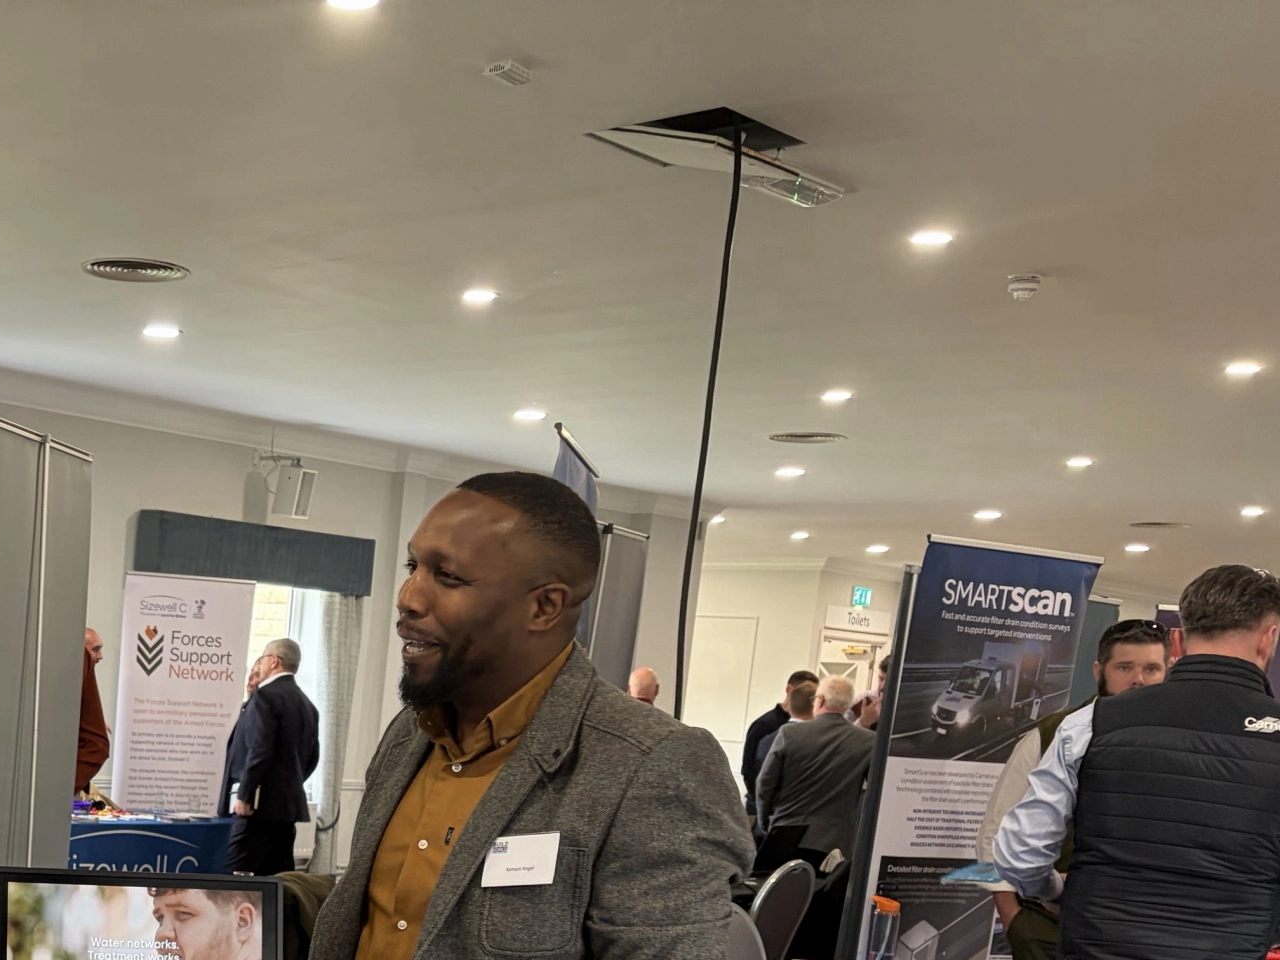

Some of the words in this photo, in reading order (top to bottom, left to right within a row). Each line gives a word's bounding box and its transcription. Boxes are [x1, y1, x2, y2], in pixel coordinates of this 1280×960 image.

[140, 600, 177, 612] Sizewell
[179, 603, 187, 613] C
[942, 579, 1072, 617] SMARTscan
[848, 612, 870, 627] Toilets
[942, 610, 954, 620] Fast
[955, 612, 965, 621] and
[966, 614, 990, 624] accurate
[991, 615, 1004, 625] filter
[1005, 617, 1019, 627] drain
[1021, 619, 1048, 630] condition
[1049, 623, 1071, 633] surveys
[171, 630, 222, 648] Forces
[964, 626, 987, 636] support
[987, 628, 1013, 638] targeted
[1013, 630, 1052, 641] interventions
[169, 647, 232, 667] Support
[168, 664, 234, 682] Network
[68, 854, 168, 874] izewell
[91, 937, 124, 948] Water
[127, 938, 180, 950] networks.
